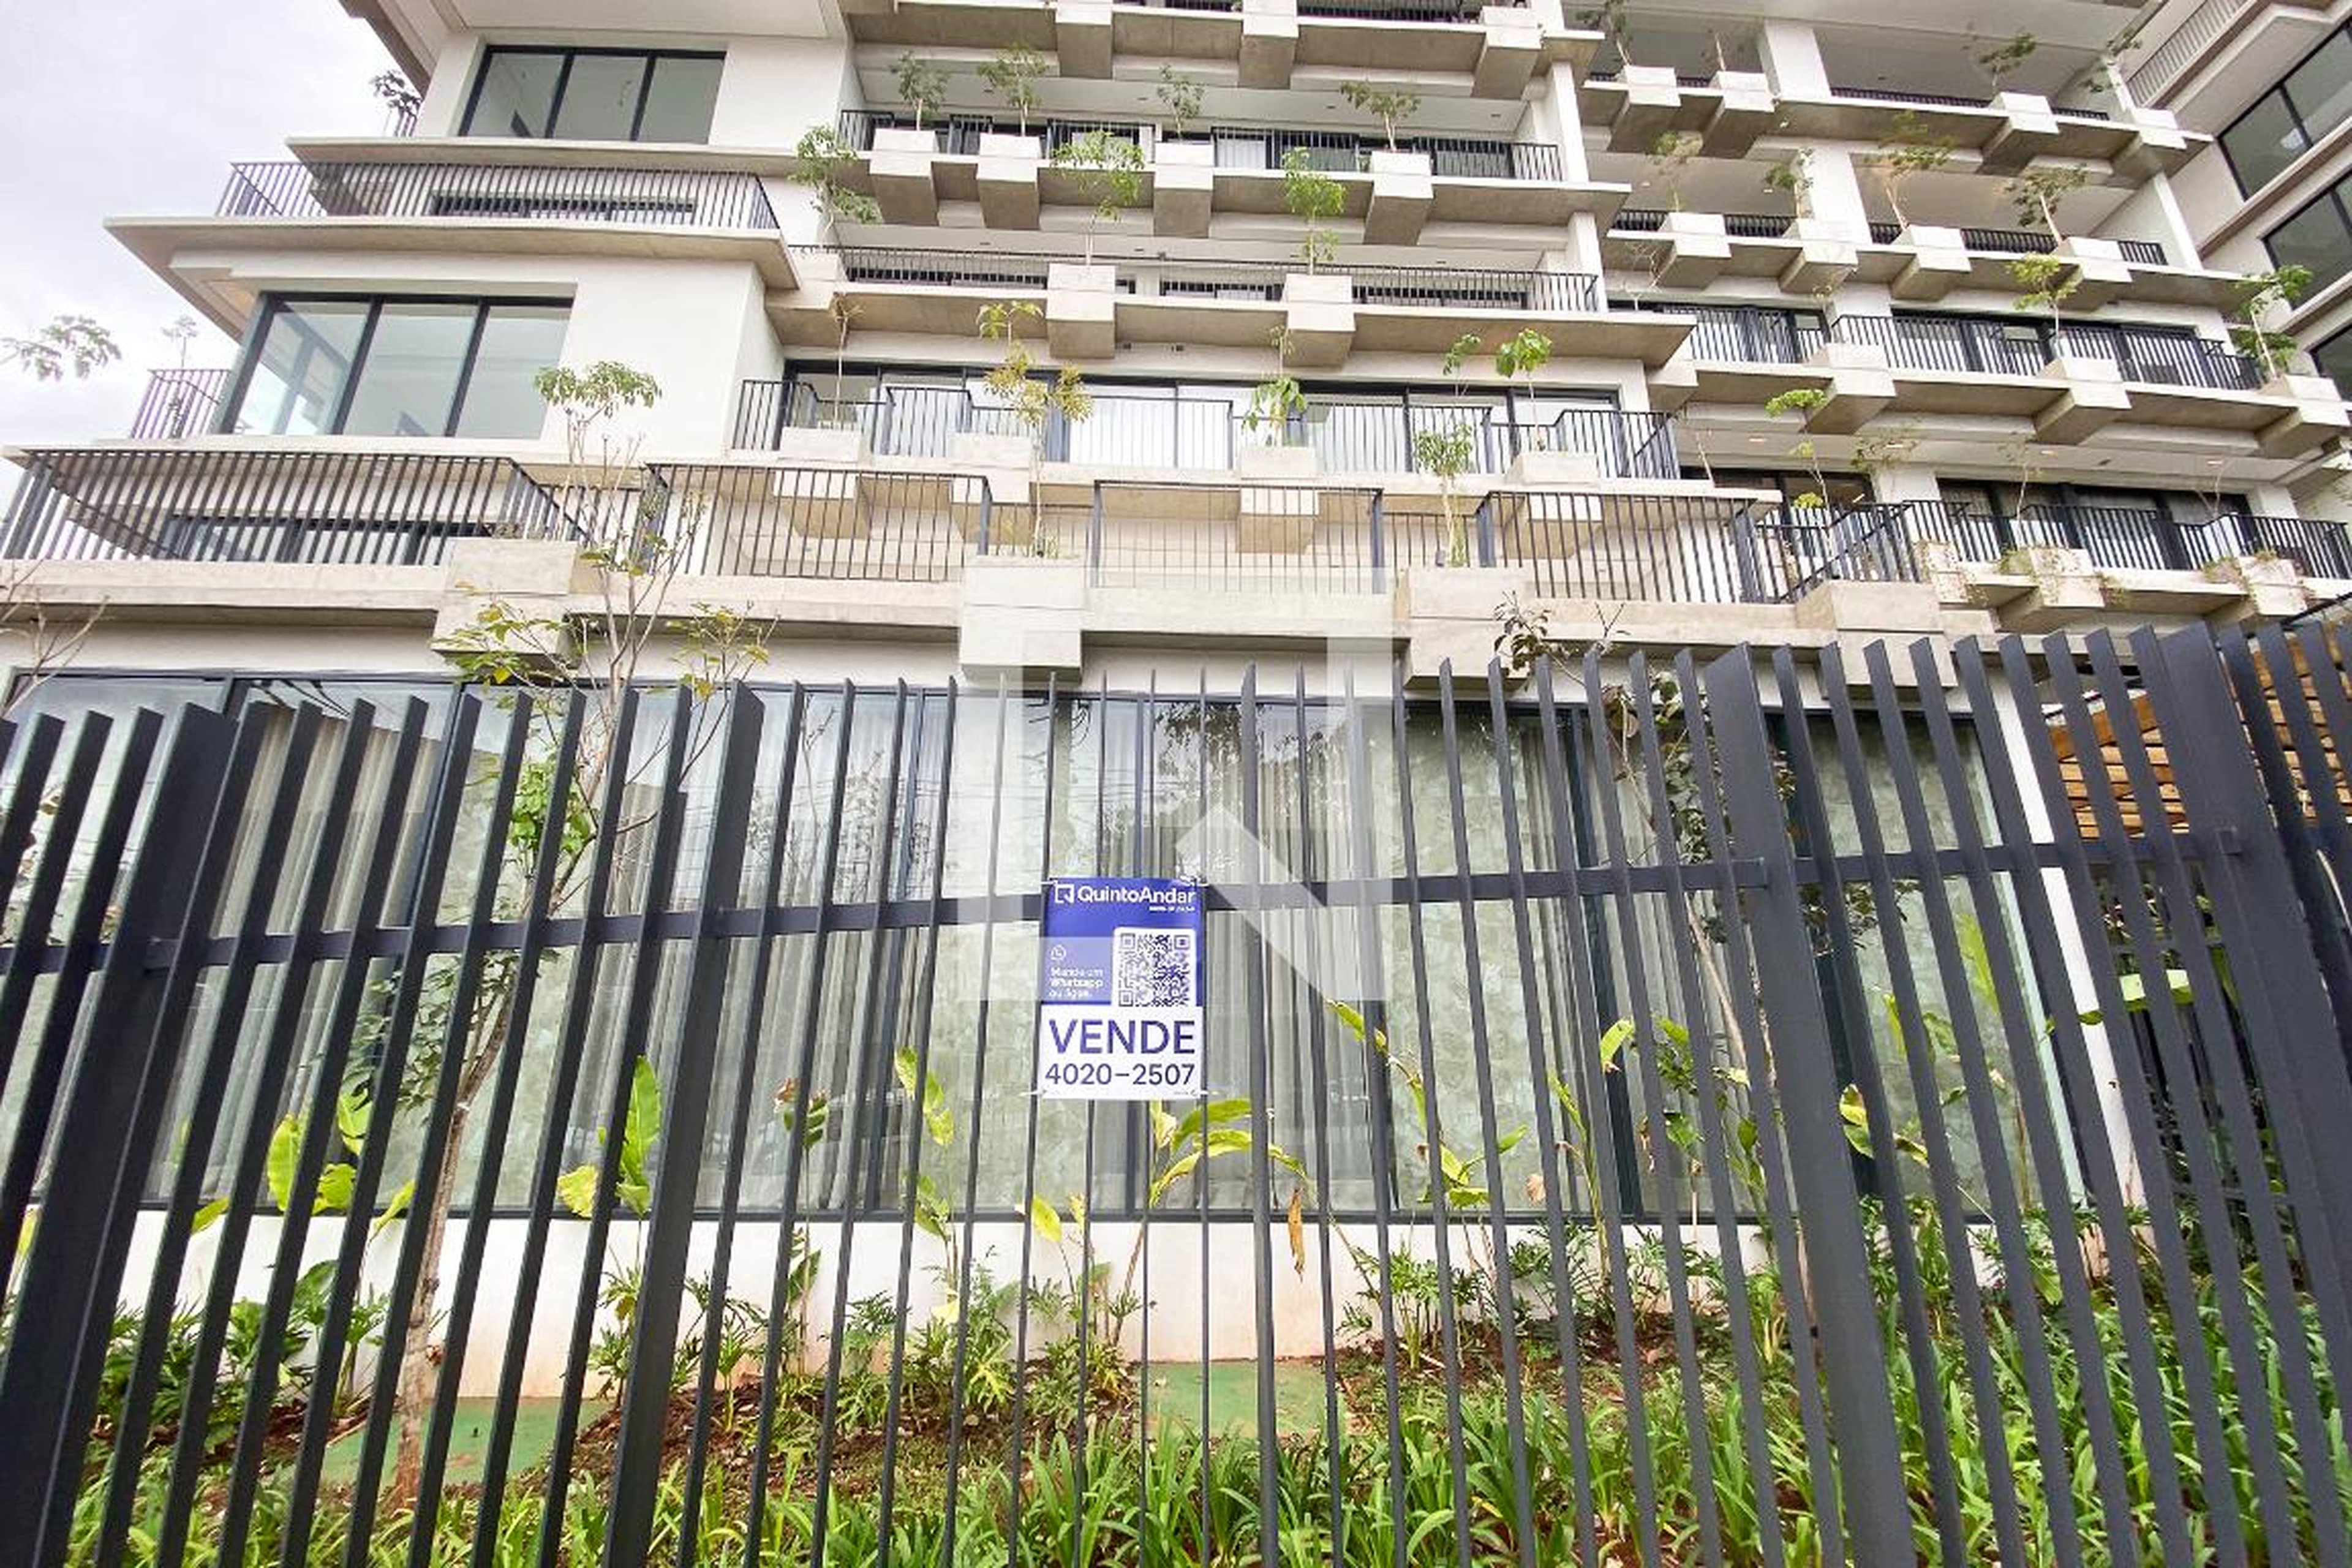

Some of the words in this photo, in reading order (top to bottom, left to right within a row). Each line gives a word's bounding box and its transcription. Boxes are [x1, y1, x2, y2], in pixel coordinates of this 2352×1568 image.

[1077, 886, 1196, 903] QuintoAndar
[1048, 1019, 1195, 1054] VENDE
[1045, 1063, 1195, 1085] 4020-2507
